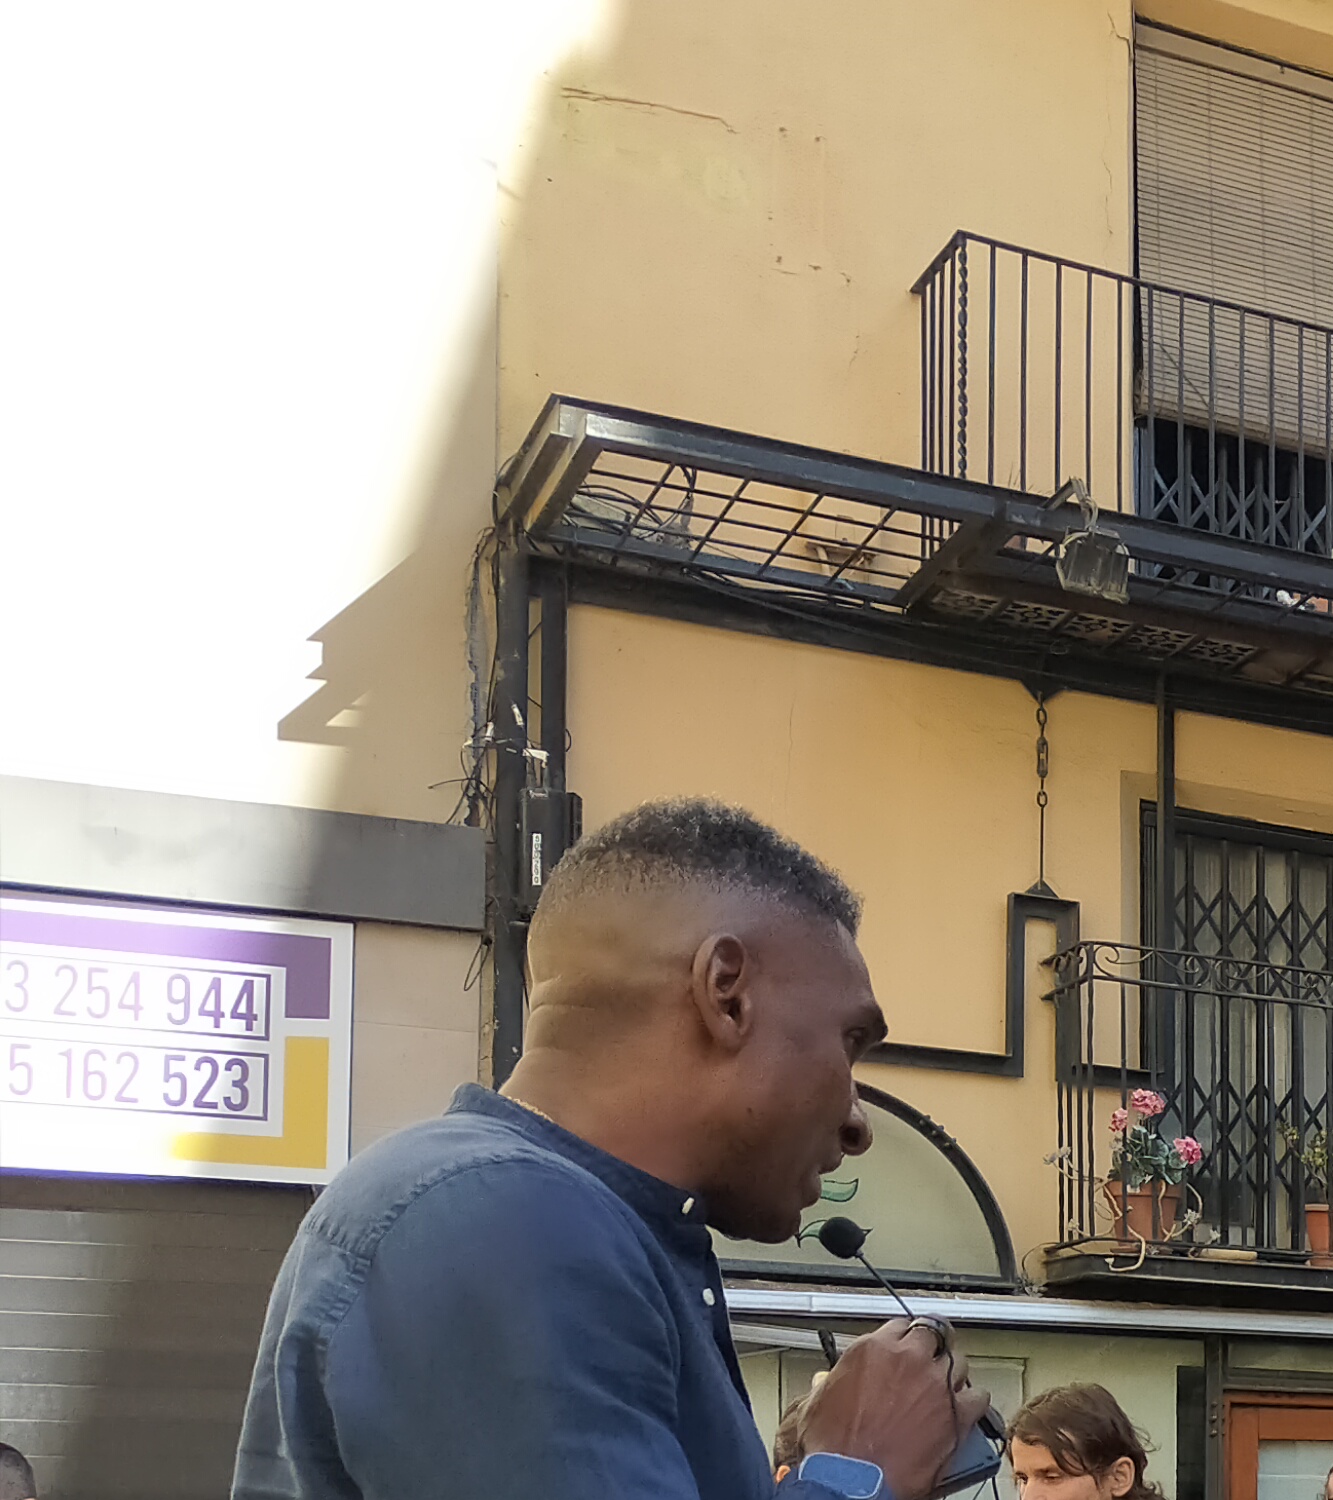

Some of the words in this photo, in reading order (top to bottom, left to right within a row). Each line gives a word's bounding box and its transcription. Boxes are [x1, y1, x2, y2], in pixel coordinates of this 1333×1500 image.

[53, 964, 143, 1022] 254
[166, 973, 258, 1033] 944
[58, 1048, 141, 1104] 162
[162, 1054, 250, 1113] 523
